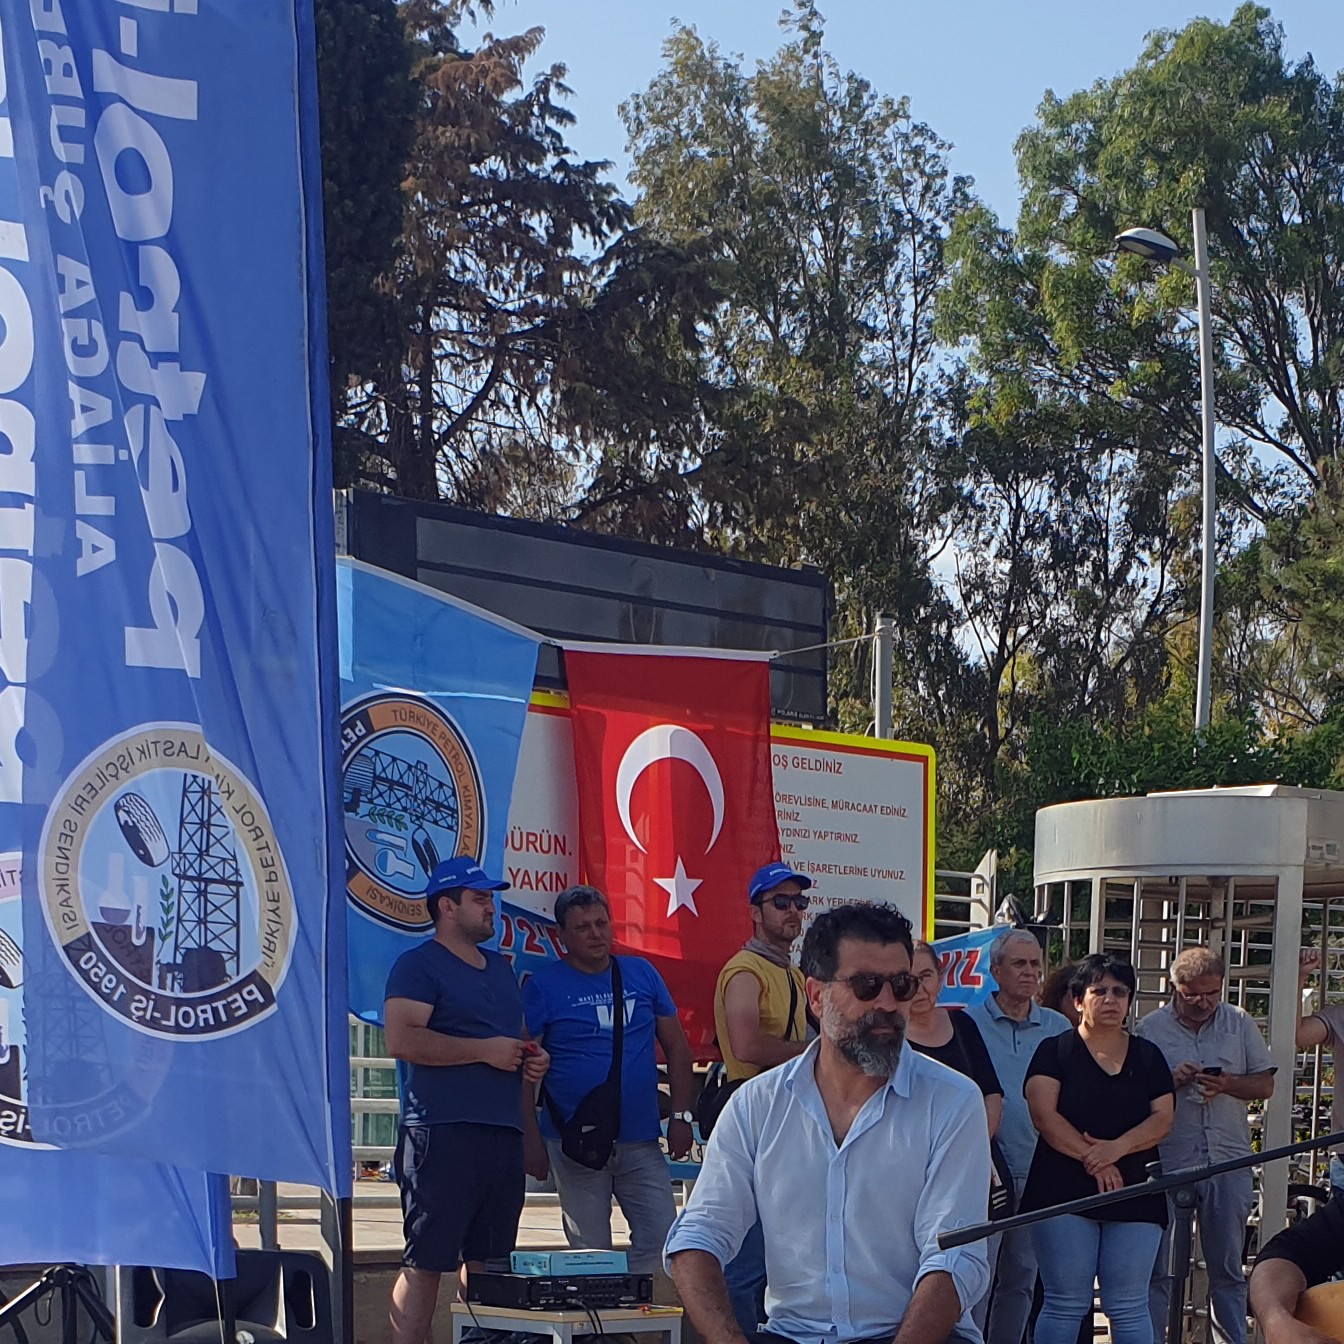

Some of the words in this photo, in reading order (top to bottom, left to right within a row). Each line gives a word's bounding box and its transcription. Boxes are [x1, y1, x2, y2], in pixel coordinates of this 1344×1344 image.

[392, 709, 440, 736] TÜRKİYE
[437, 733, 465, 784] PETROL
[772, 754, 789, 770] OŞ
[792, 756, 844, 776] GELDİNİZ
[774, 791, 830, 811] ÖREVLİSİNE,
[831, 799, 879, 815] MÜRACAAT
[777, 809, 802, 823] RİNİZ.
[504, 826, 573, 857] ÜRÜN.
[780, 828, 811, 838] YDINIZI
[508, 866, 568, 893] YAKIN
[794, 862, 806, 872] VE
[807, 862, 869, 878] İŞARETLERİNE
